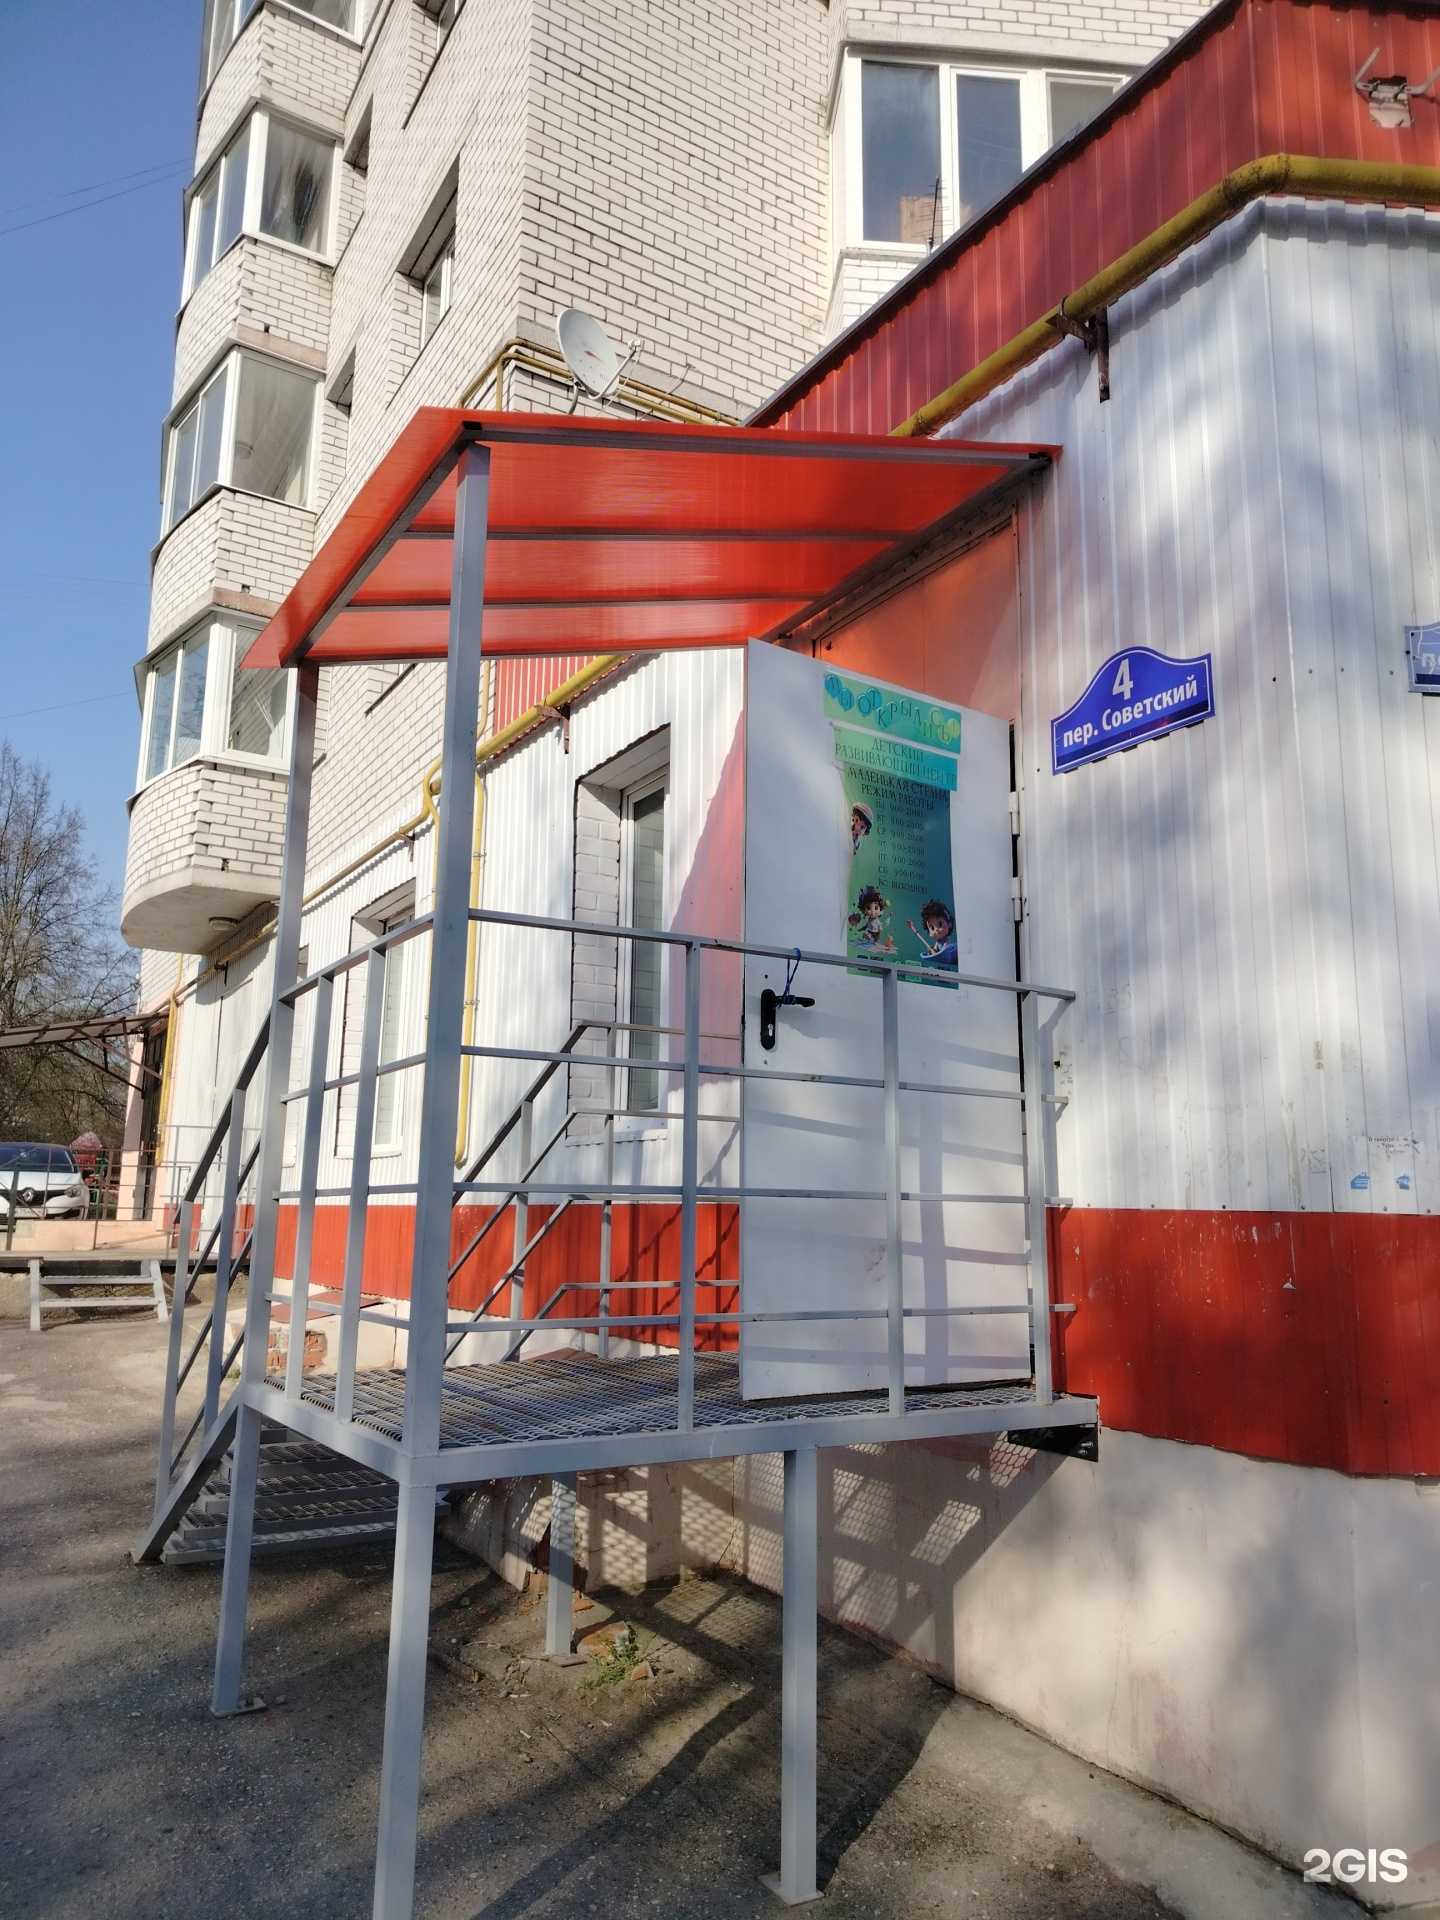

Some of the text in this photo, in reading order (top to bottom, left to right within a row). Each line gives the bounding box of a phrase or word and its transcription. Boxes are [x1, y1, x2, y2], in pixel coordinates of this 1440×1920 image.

[1112, 658, 1134, 700] 4
[1063, 674, 1198, 748] пер. Советский
[872, 738, 924, 762] ДЕТСКИЙ
